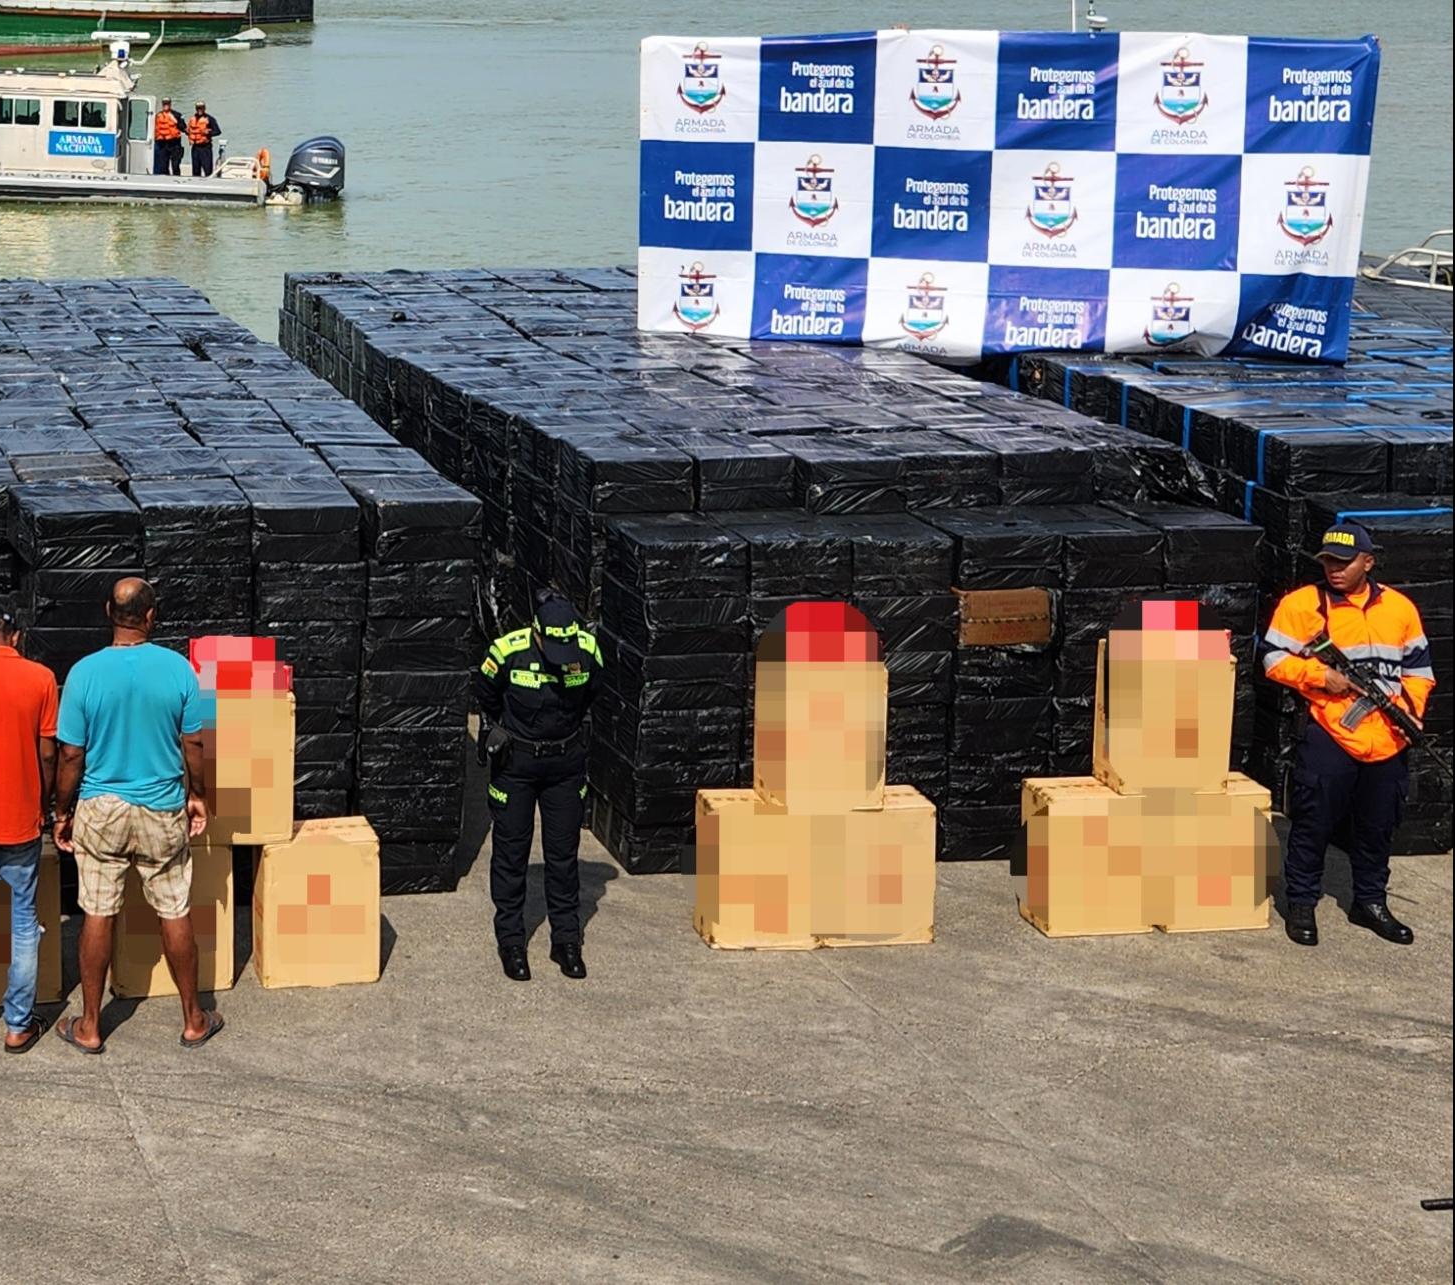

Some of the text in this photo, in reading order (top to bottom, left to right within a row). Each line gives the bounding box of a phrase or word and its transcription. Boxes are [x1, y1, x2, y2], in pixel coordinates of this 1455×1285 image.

[792, 61, 854, 79] Protegemos
[1030, 66, 1095, 85] Protegemos
[1283, 67, 1353, 86] Protegemos
[780, 86, 854, 113] bandera
[1017, 93, 1094, 120] bandera
[1269, 95, 1351, 122] bandera
[675, 118, 726, 127] ARMADA
[908, 124, 960, 134] ARMADA
[58, 134, 101, 146] ARMADA
[1152, 129, 1208, 139] ARMADA
[55, 143, 105, 154] NACIONAL
[675, 170, 735, 188] Protegemos
[906, 177, 969, 197] Protegemos
[1149, 184, 1217, 203] Protegemos
[664, 194, 735, 222] bandera
[893, 202, 969, 231] bandera
[1136, 211, 1216, 240] bandera
[787, 231, 838, 241] ARMADA
[1023, 242, 1077, 252] ARMADA
[1275, 250, 1329, 260] ARMADA
[784, 284, 846, 303] Protegemos
[1019, 296, 1084, 314] Protegemos
[770, 308, 844, 335] bandera
[1005, 321, 1082, 349] bandera
